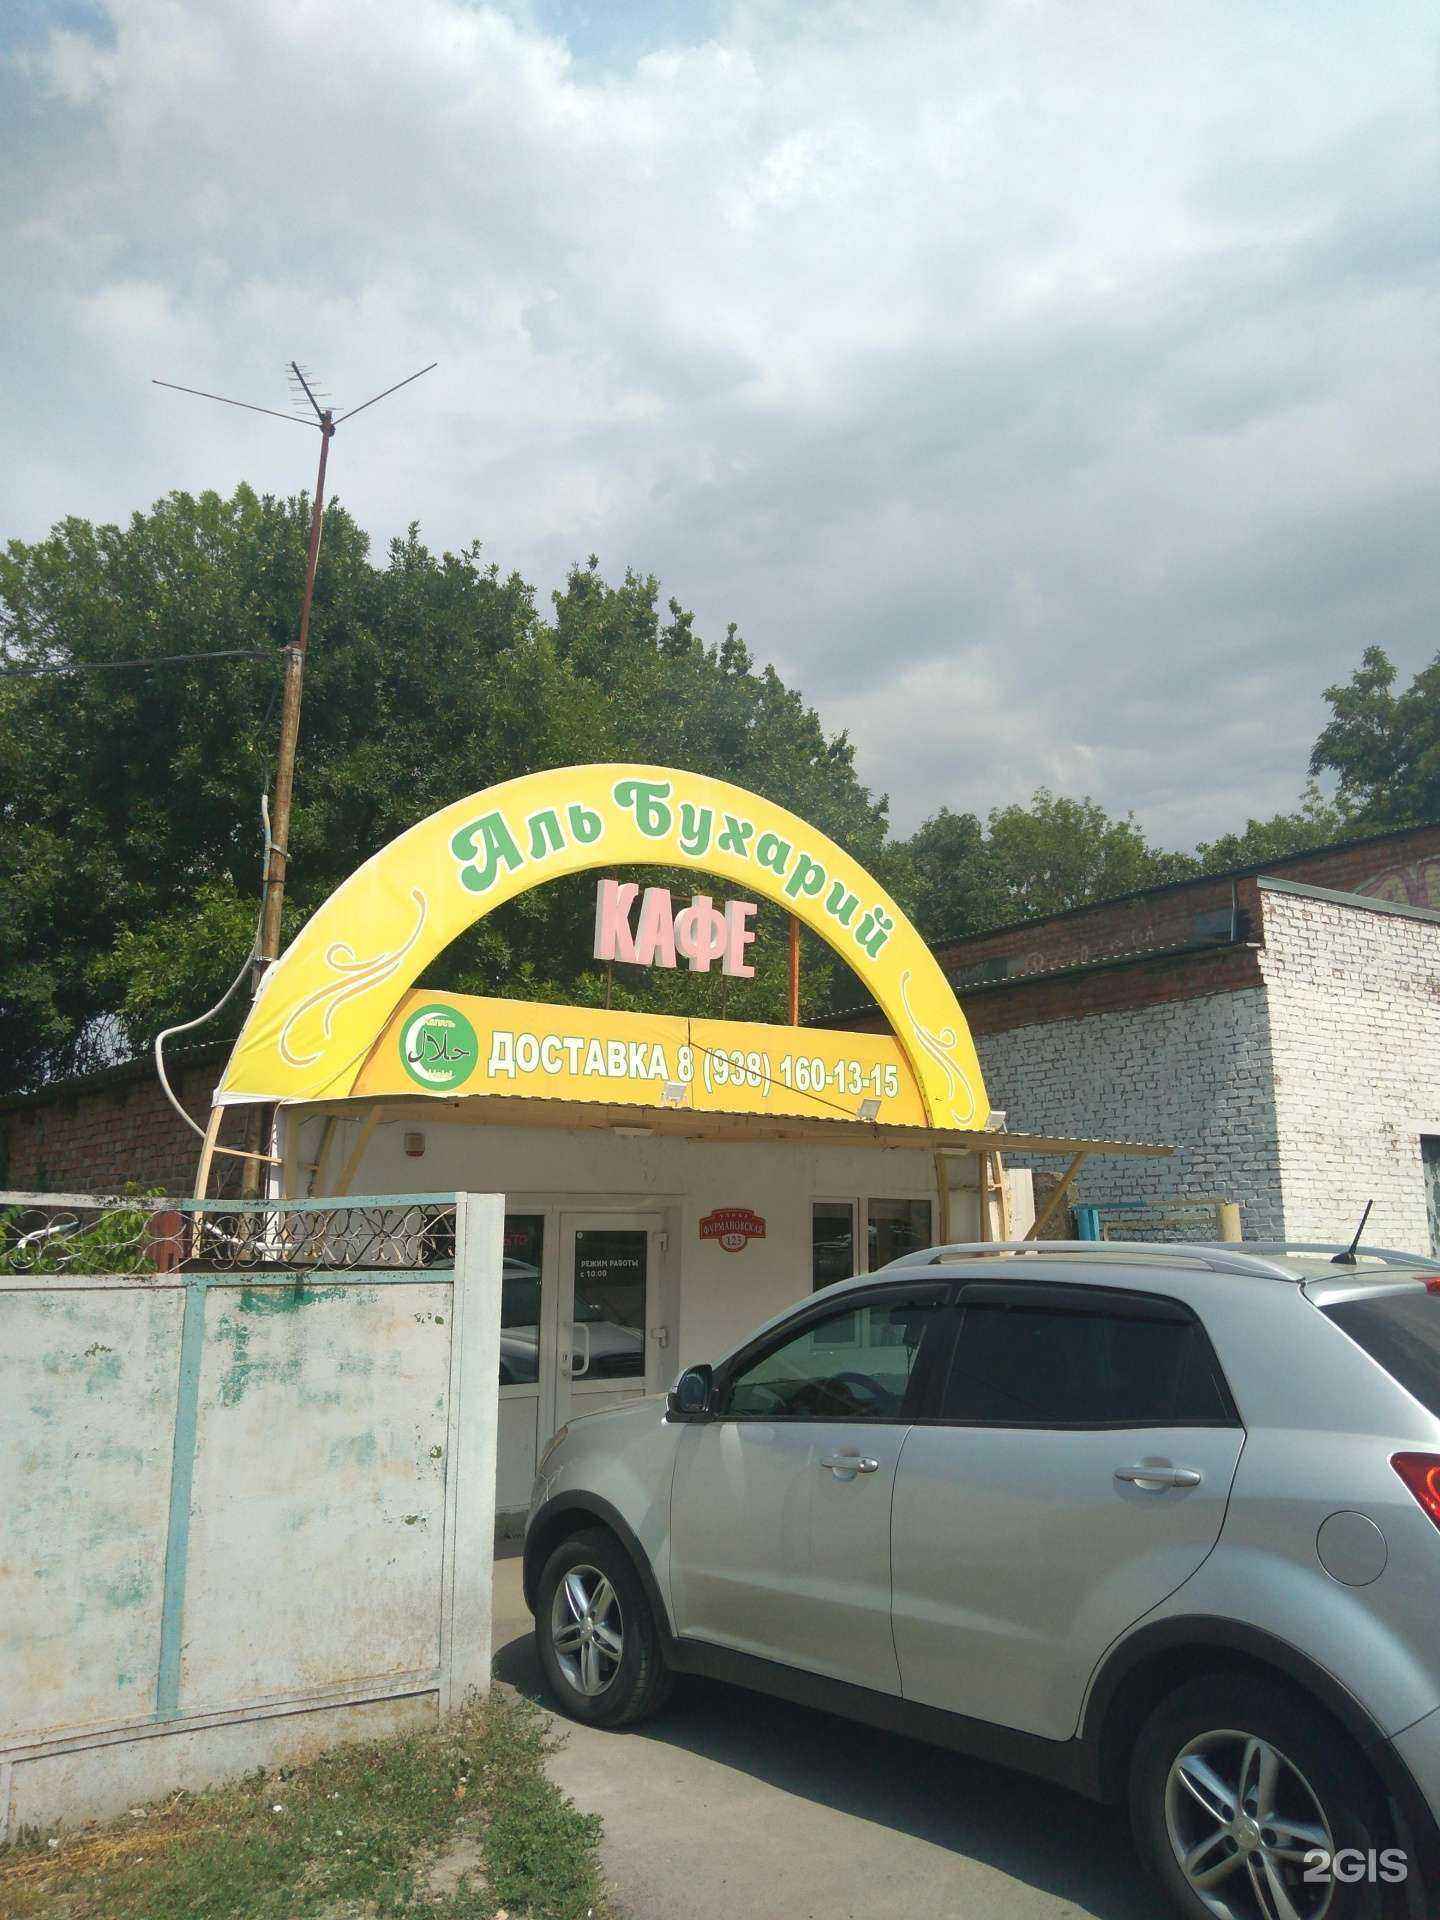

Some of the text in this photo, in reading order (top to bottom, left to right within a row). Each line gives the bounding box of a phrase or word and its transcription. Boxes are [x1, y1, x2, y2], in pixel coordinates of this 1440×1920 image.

[451, 780, 894, 958] Аль Бухарий
[593, 878, 758, 978] КАФЕ
[487, 1030, 899, 1098] ДОСТАВКА 8 (938) 160-13-15
[580, 1259, 639, 1268] РЕЖИМ РАБОТЫ
